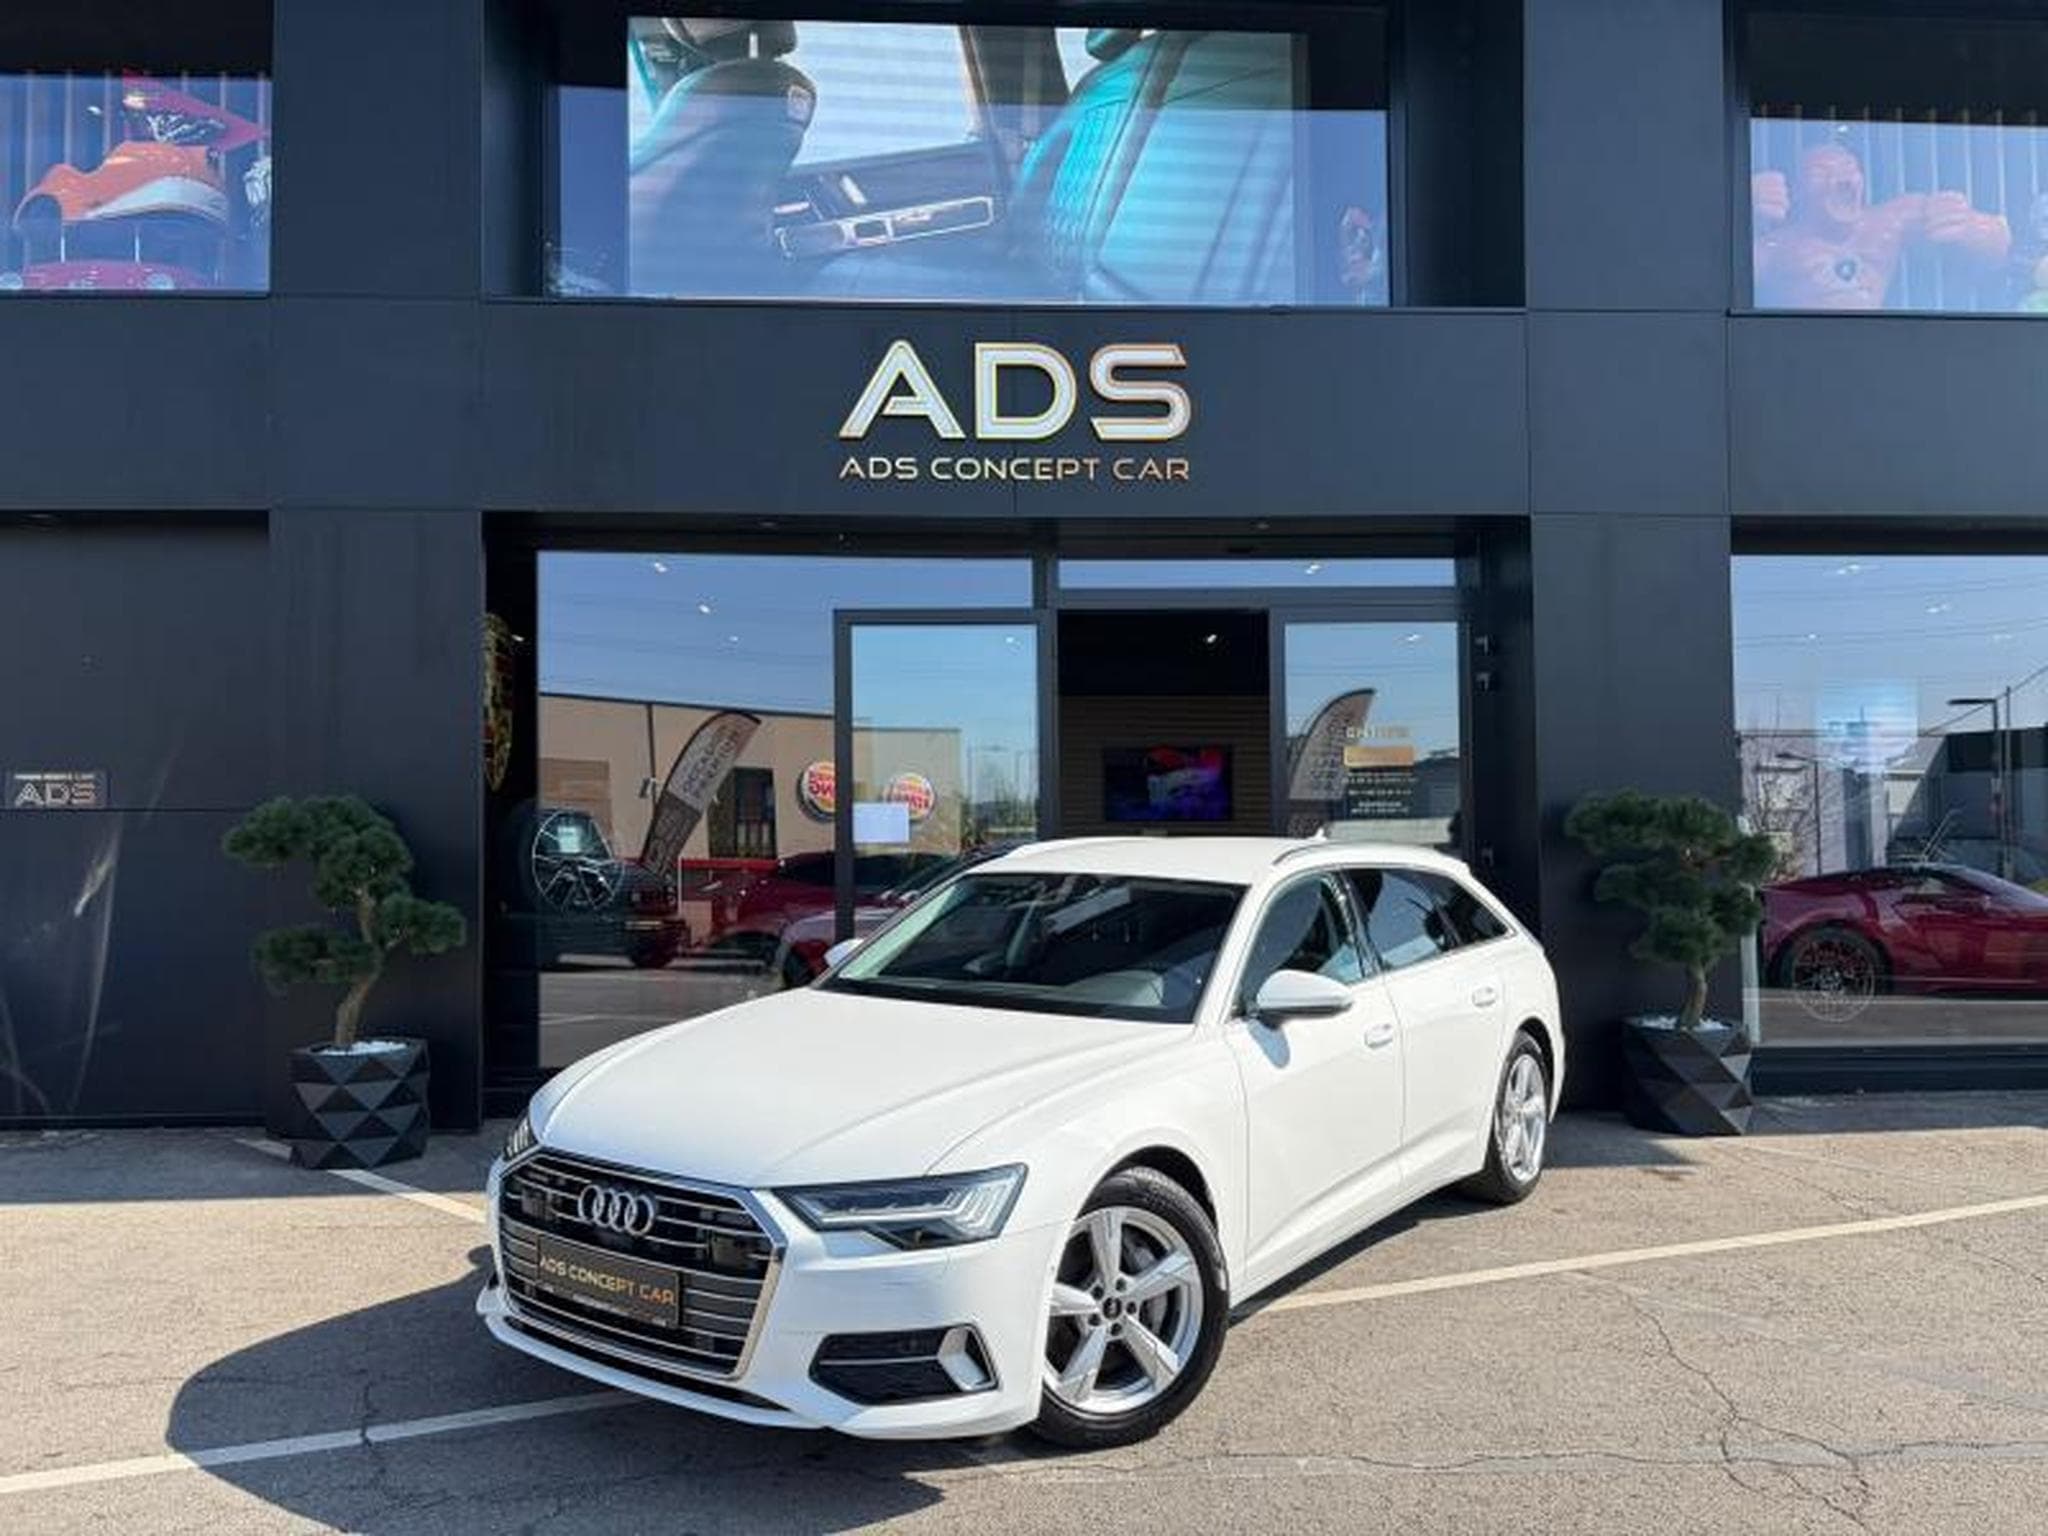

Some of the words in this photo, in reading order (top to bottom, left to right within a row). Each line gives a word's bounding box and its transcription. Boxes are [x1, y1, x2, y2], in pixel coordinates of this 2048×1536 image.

[838, 339, 1192, 440] ADS
[838, 456, 919, 480] ADS
[930, 456, 1101, 480] CONCEPT
[1112, 457, 1190, 481] CAR
[15, 782, 97, 807] ADS
[568, 1265, 636, 1297] CONCEPT
[639, 1284, 674, 1306] CAR
